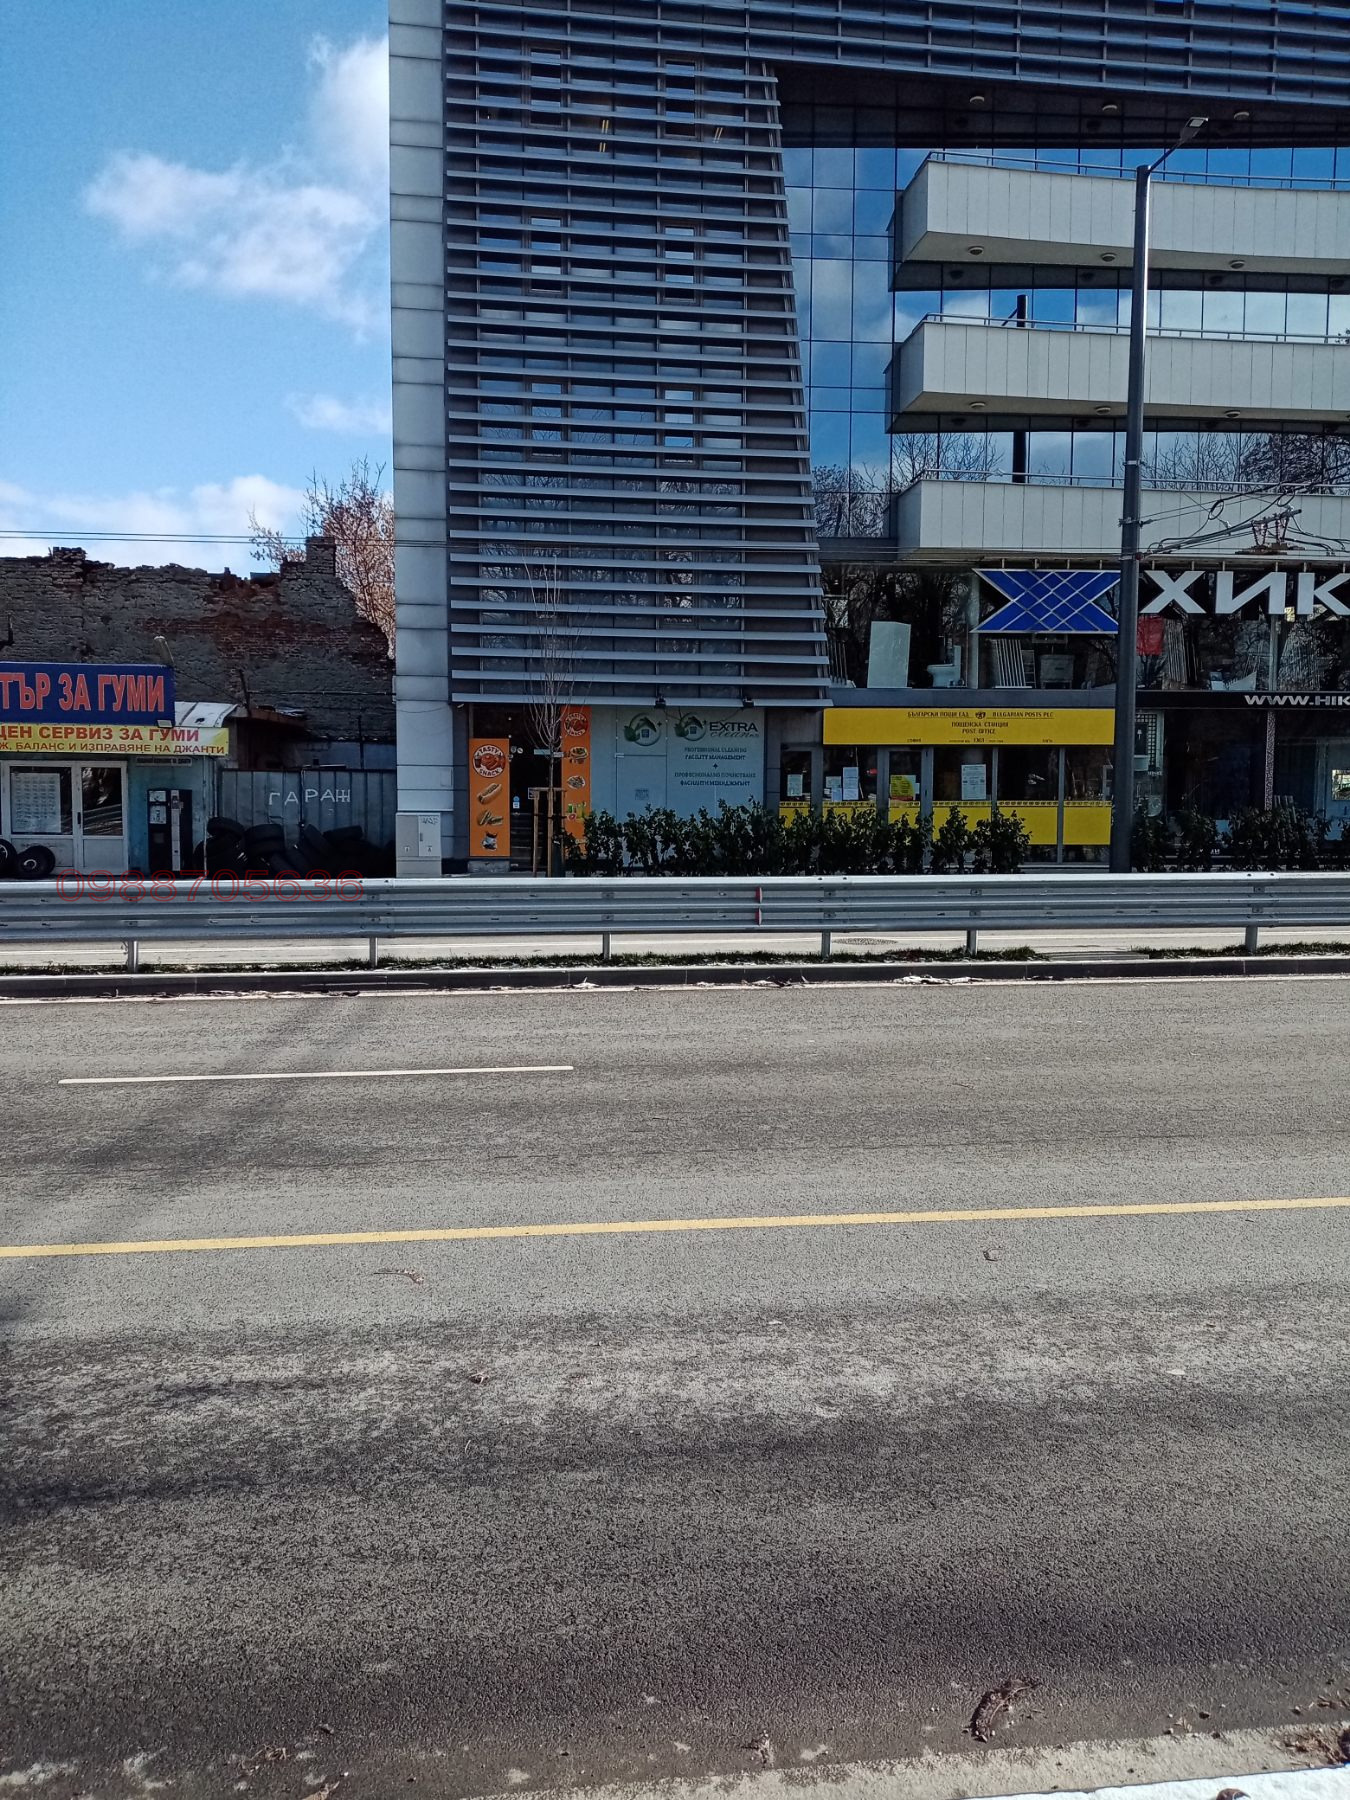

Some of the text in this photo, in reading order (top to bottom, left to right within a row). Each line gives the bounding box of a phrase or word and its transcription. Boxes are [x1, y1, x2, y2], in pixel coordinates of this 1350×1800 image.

[58, 673, 91, 711] ЗА
[97, 674, 164, 712] ГУМИ
[709, 721, 758, 732] EXTRA
[38, 726, 113, 740] СЕРВИЗ
[119, 728, 143, 741] ЗА
[149, 729, 199, 742] ГУМИ
[80, 743, 151, 752] ИЗПРАВЯНЕ
[173, 745, 225, 754] ДЖАНТИ
[475, 746, 503, 756] TASTY
[268, 788, 351, 806] ГАРАЖ
